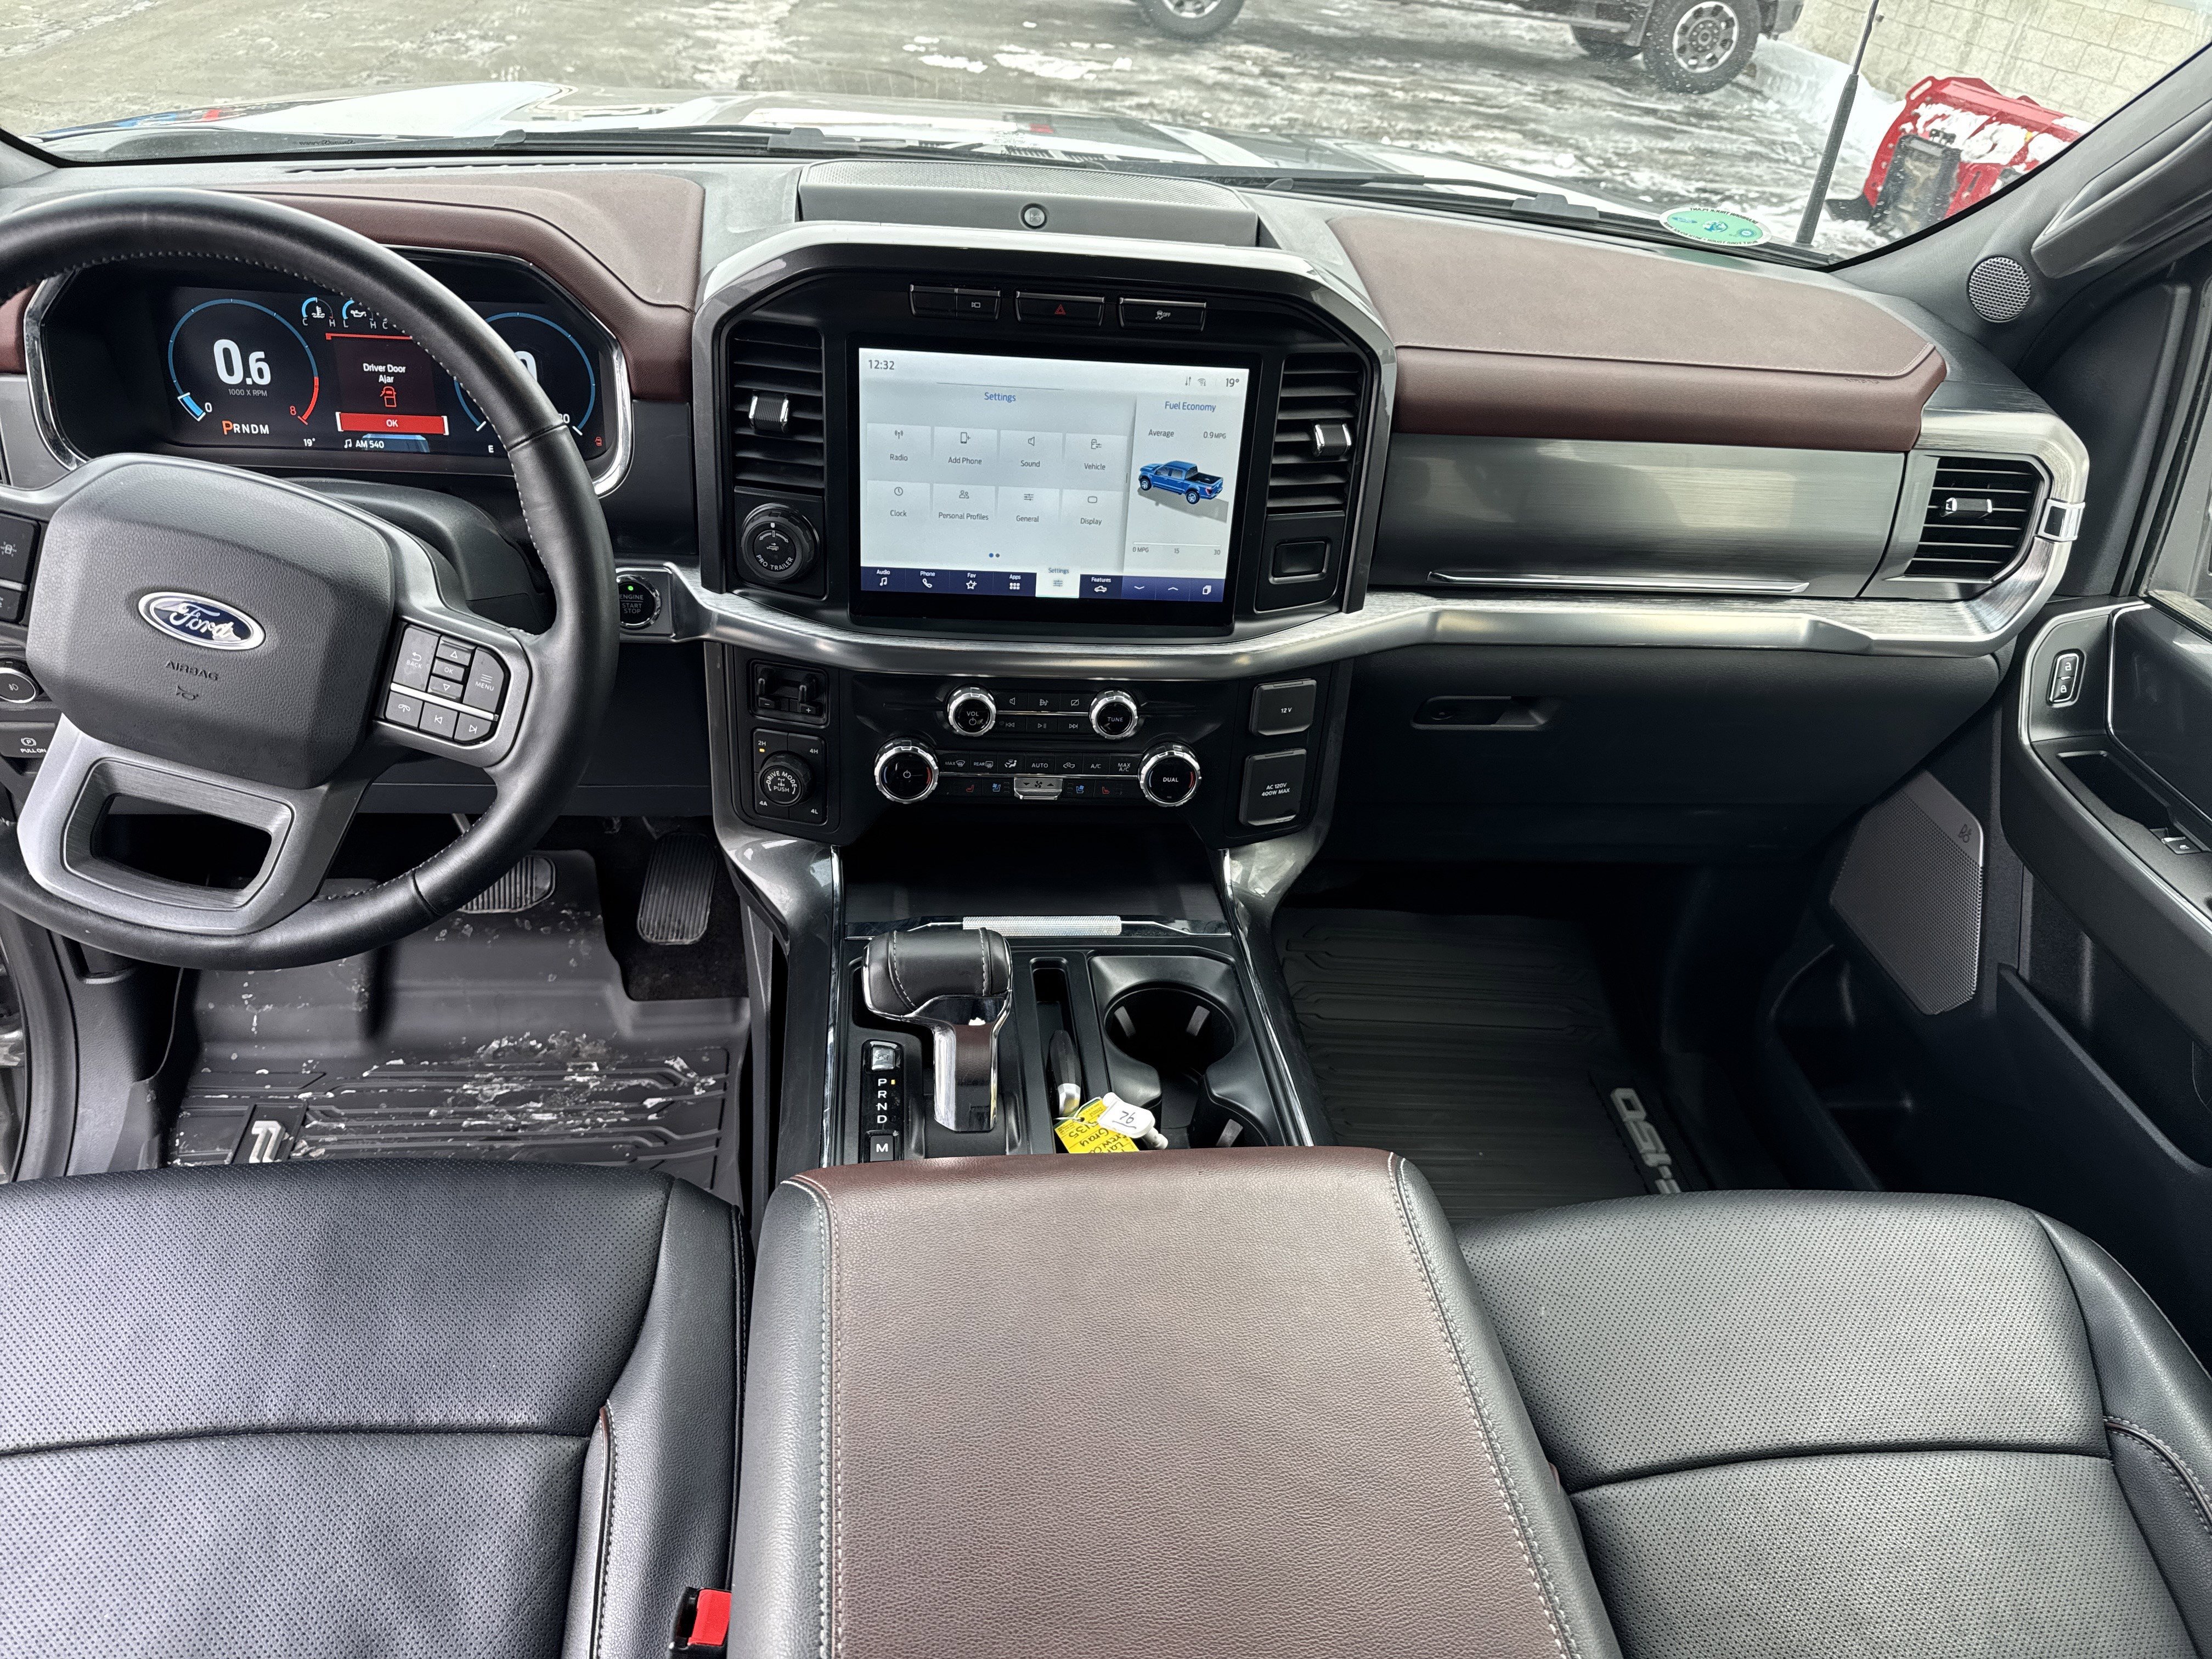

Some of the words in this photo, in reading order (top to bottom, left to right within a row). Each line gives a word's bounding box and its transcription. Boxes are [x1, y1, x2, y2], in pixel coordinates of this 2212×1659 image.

[329, 319, 336, 328] H
[343, 319, 349, 328] L
[369, 321, 377, 329] H
[213, 338, 272, 386] 0.6
[868, 359, 895, 370] 12:32
[363, 363, 385, 373] Driver
[386, 364, 406, 373] Door
[378, 374, 394, 385] Ajar
[984, 392, 1016, 403] Settings
[205, 402, 213, 413] 0
[289, 405, 297, 416] 8
[1165, 401, 1181, 410] Fuel
[1182, 402, 1216, 413] Economy
[386, 419, 399, 428] OK
[1148, 429, 1175, 438] Average
[355, 439, 368, 448] AM
[369, 440, 385, 449] 540
[488, 445, 494, 453] E
[889, 453, 908, 461] Radio
[756, 554, 768, 567] PRO
[770, 557, 794, 571] TRAILER
[169, 601, 234, 639] Ford
[406, 659, 423, 670] BACK
[165, 659, 219, 681] AIRBAG
[444, 667, 454, 675] OK
[475, 680, 495, 692] MENU
[766, 770, 781, 785] DRIVE
[781, 771, 797, 788] MODE
[878, 1090, 887, 1098] R
[877, 1103, 887, 1111] N
[877, 1115, 888, 1124] D
[1079, 1127, 1109, 1147] Gray
[876, 1143, 888, 1153] M
